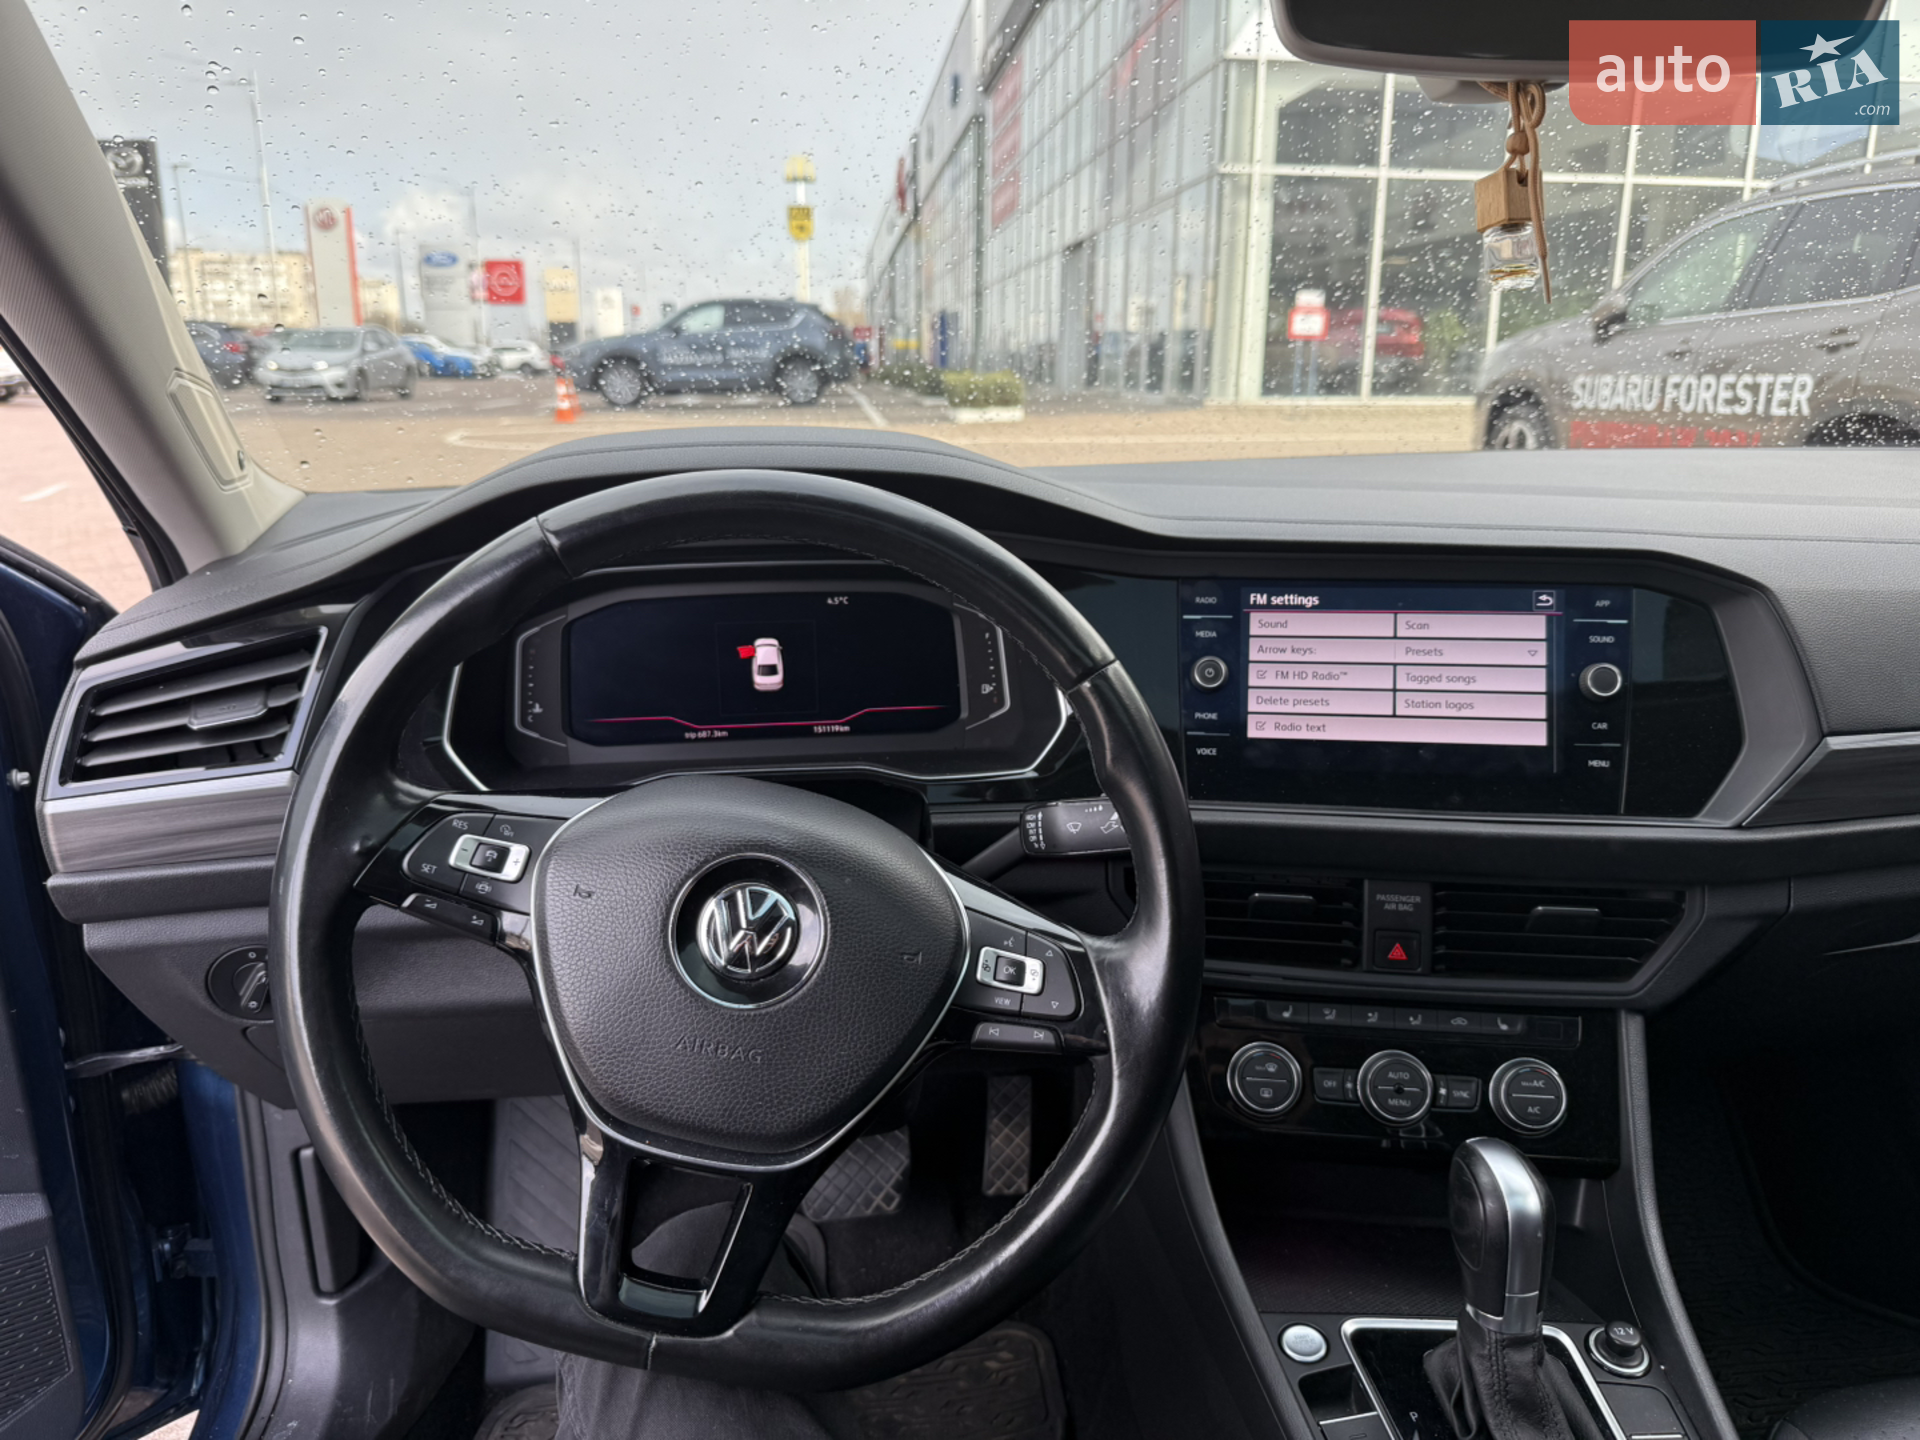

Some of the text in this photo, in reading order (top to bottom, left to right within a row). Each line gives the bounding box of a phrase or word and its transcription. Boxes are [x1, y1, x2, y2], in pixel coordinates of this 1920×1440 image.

[1571, 373, 1815, 417] SUBARU FORESTER
[1195, 596, 1217, 604] RADIO
[1249, 592, 1320, 608] FM settings
[1594, 600, 1611, 608] APP
[1257, 618, 1289, 629] Sound
[1404, 620, 1431, 631] Scan
[1195, 630, 1217, 638] MEDIA
[1588, 635, 1616, 644] SOUND
[1256, 644, 1318, 657] Arrow keys:
[1404, 646, 1445, 657] Presets
[1274, 670, 1290, 681] FM
[1292, 671, 1309, 681] HD
[1404, 672, 1477, 686] Tagged songs
[1255, 695, 1330, 708] Delete presets
[1403, 698, 1475, 712] Station logos
[1194, 712, 1219, 721] PHONE
[1273, 721, 1327, 733] Radio text
[1591, 722, 1609, 731] CAR
[1195, 747, 1218, 756] VOICE
[1587, 759, 1611, 768] MENU
[451, 818, 469, 831] RES
[421, 862, 438, 875] SET
[1376, 893, 1421, 904] PASSENGER
[1384, 902, 1414, 912] AIR BAG
[1003, 966, 1016, 976] OK
[994, 997, 1011, 1006] VIEW
[675, 1033, 763, 1064] AIRBAG
[1387, 1070, 1411, 1081] AUTO
[1323, 1079, 1338, 1088] OFF
[1387, 1098, 1412, 1108] MENU
[1527, 1105, 1541, 1115] A/C
[1613, 1327, 1635, 1336] 12 V
[1409, 1411, 1419, 1423] P
